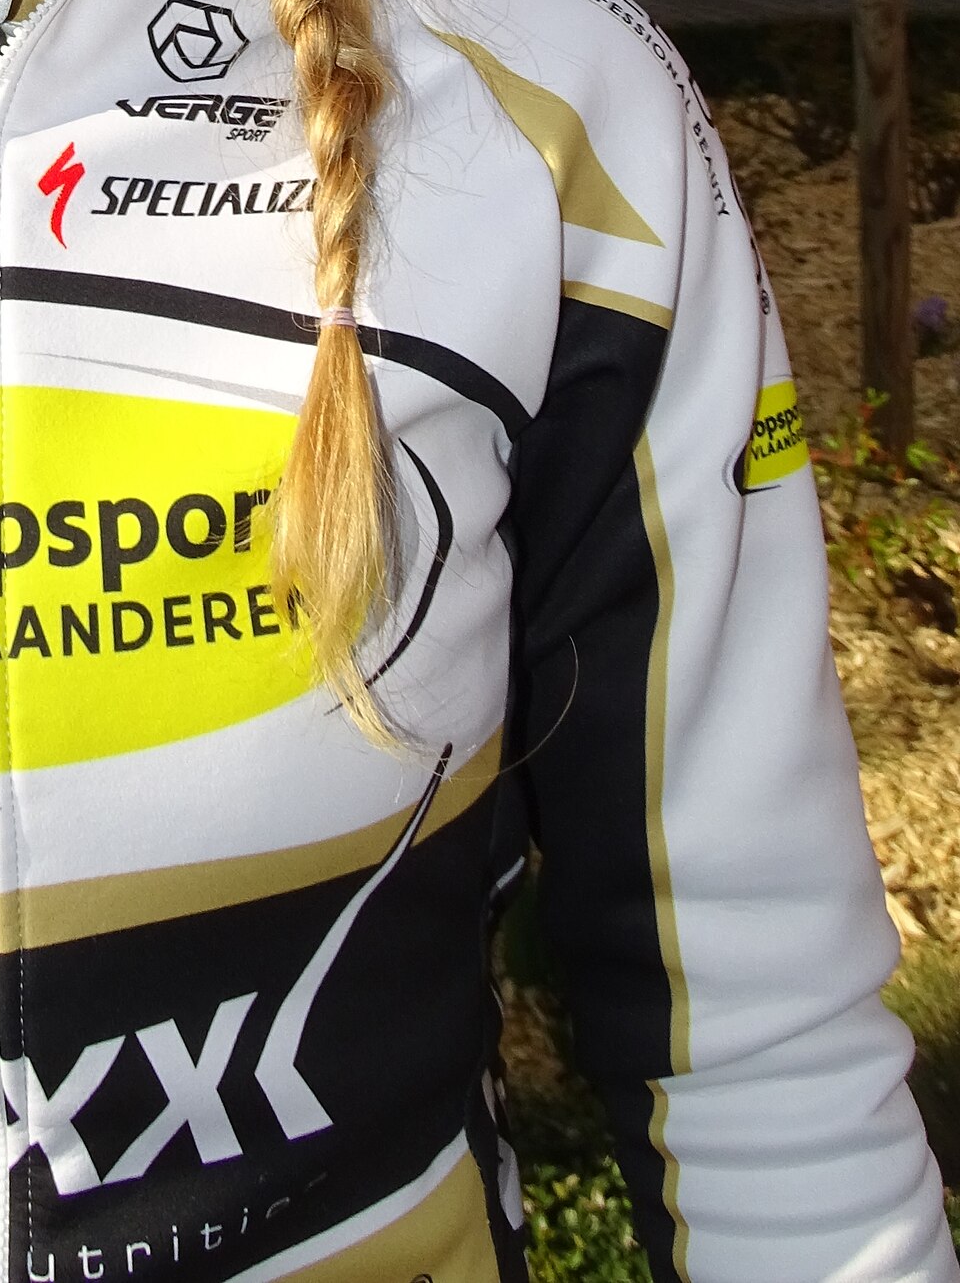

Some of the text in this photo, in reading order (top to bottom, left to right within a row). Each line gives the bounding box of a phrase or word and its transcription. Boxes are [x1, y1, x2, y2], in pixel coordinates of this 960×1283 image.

[115, 94, 291, 128] VERGE
[225, 127, 272, 143] SPORT
[692, 120, 731, 218] BEAUTY
[90, 175, 318, 217] SPECIALIZ
